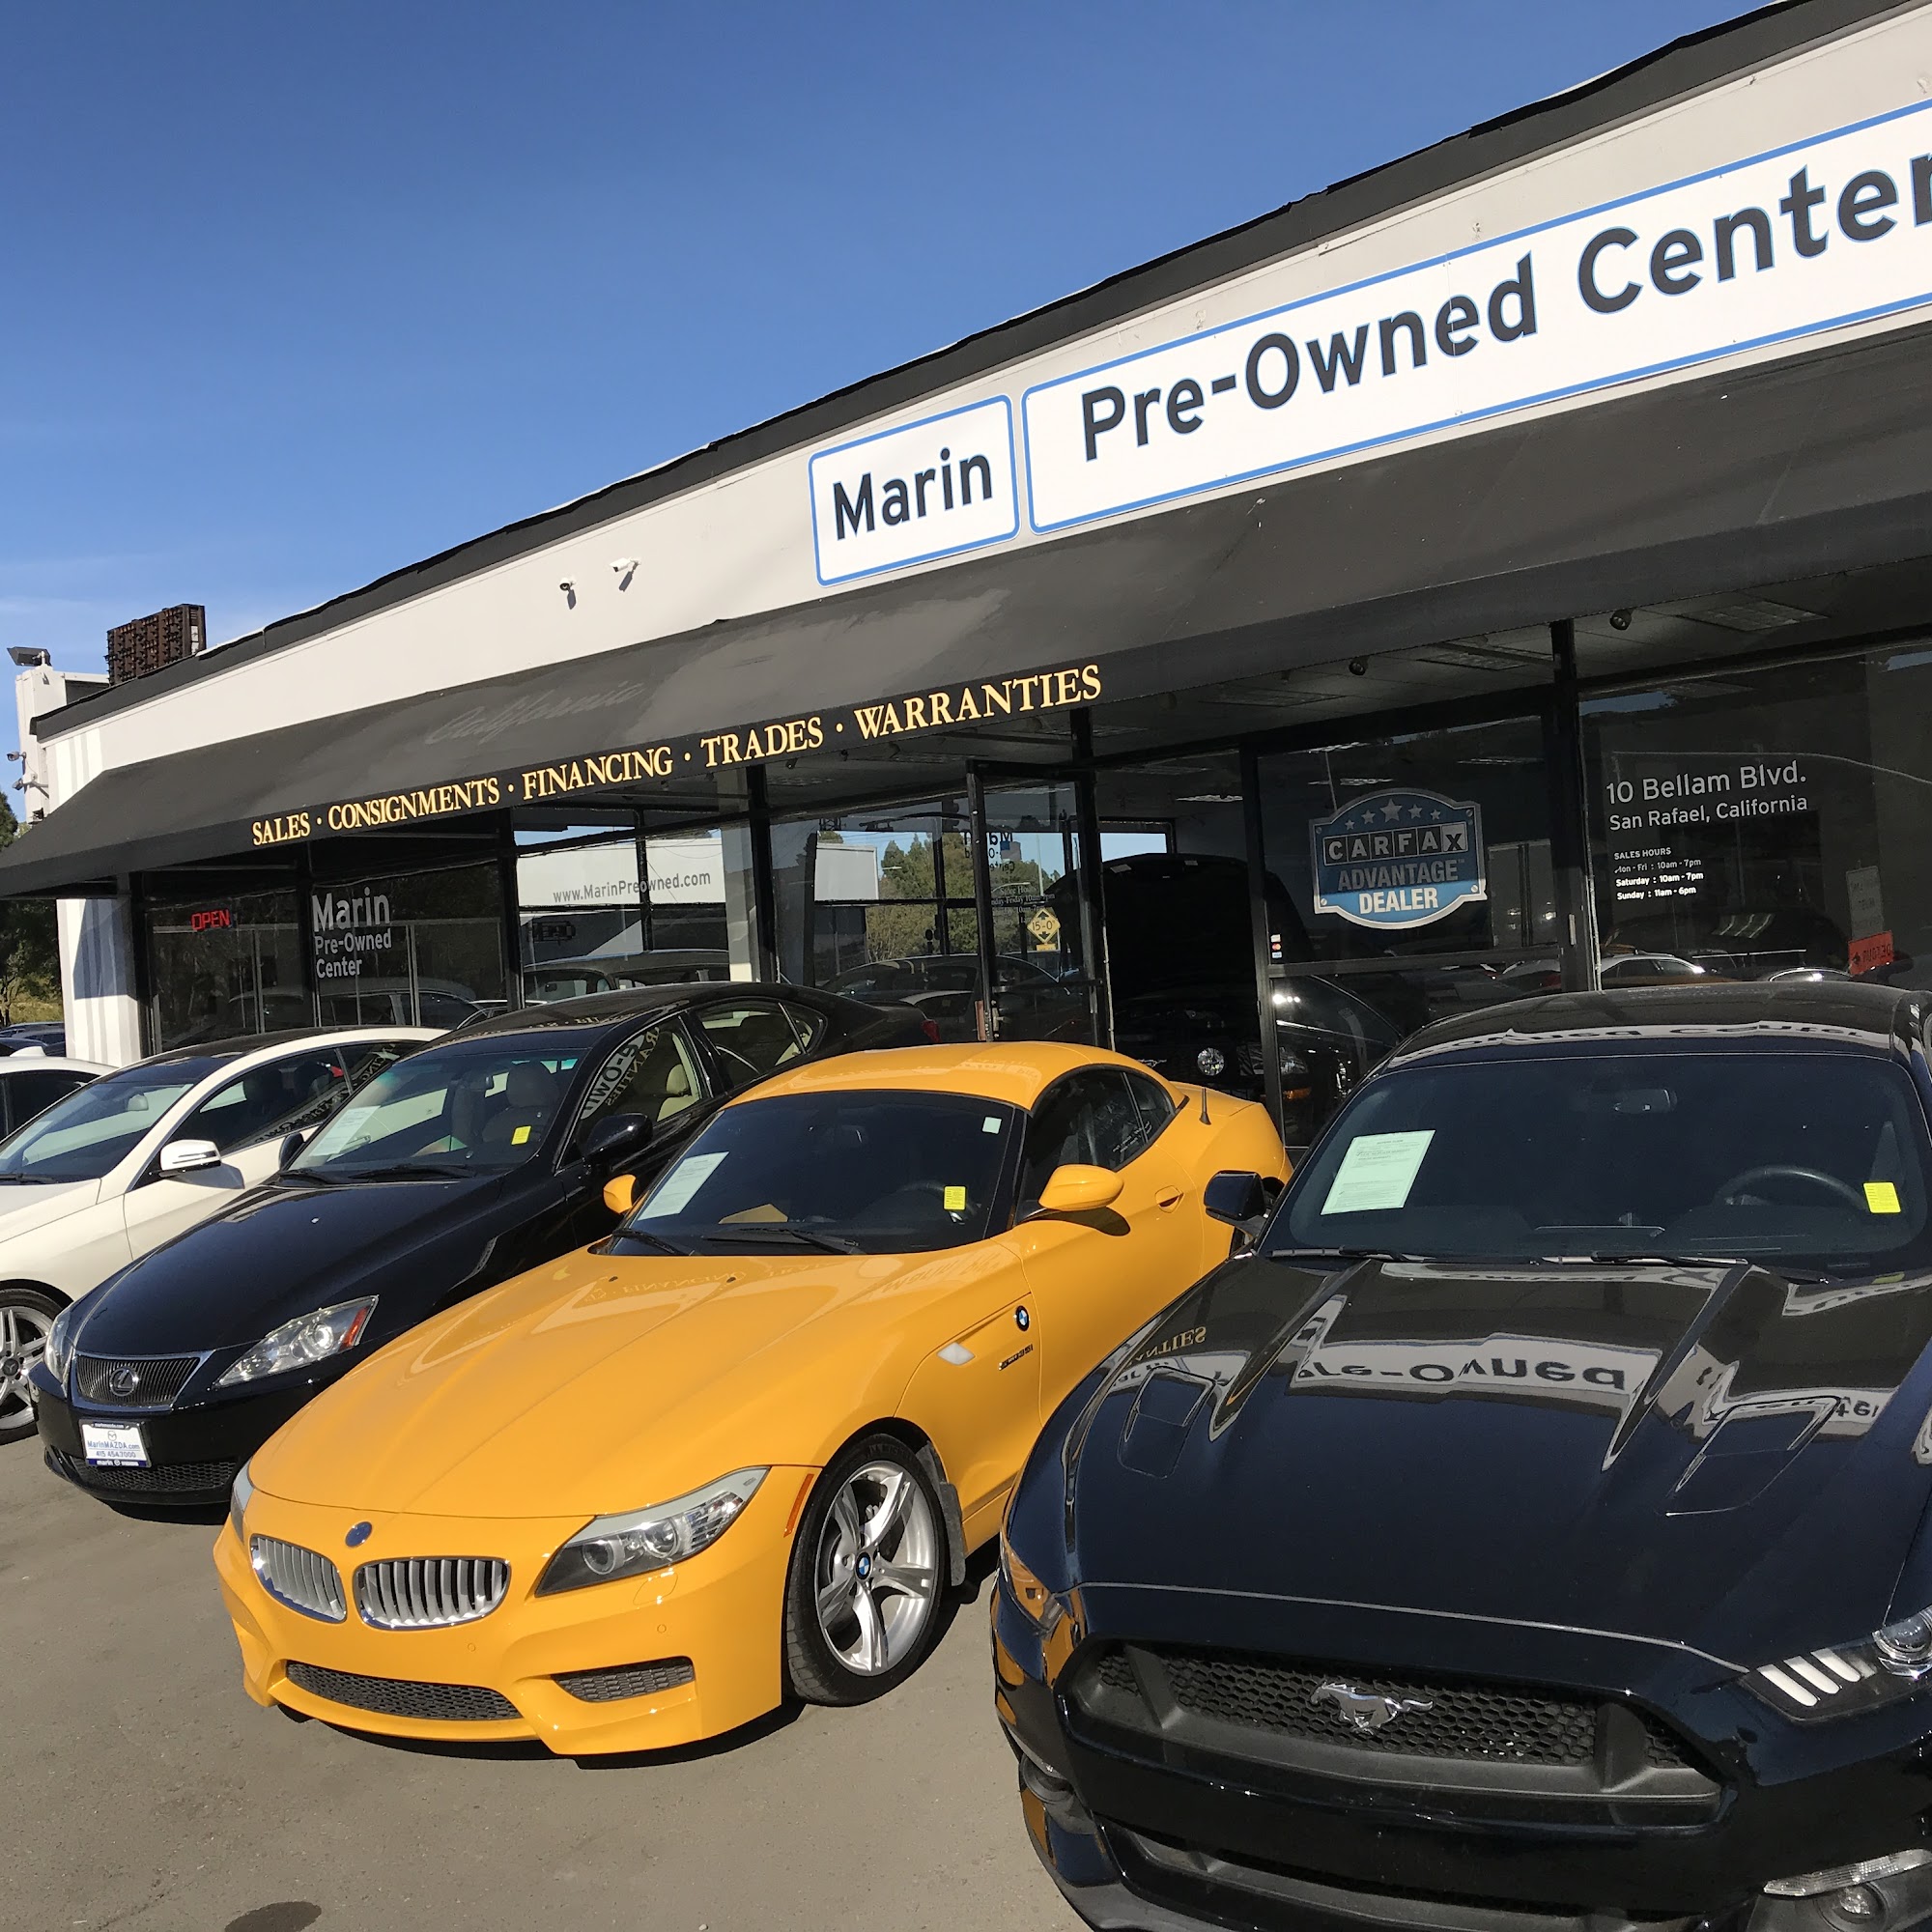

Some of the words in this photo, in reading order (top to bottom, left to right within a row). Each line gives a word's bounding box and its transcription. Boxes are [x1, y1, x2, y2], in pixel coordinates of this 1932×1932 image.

[1082, 250, 1538, 462] Pre-Owned
[833, 447, 993, 541] Marin
[251, 811, 311, 846] SALES
[327, 777, 500, 831] CONSIGNMENTS
[522, 746, 674, 801] FINANCING
[699, 716, 825, 769] TRADES
[853, 664, 1102, 740] WARRANTIES
[1606, 781, 1634, 805] 10
[1642, 773, 1730, 801] Bellam
[1740, 760, 1806, 789] Blvd.
[1609, 814, 1643, 831] San
[1648, 805, 1711, 827] Rafael,
[1716, 794, 1808, 819] California
[1327, 830, 1467, 861] CARFAX
[1613, 850, 1641, 861] SALES
[1641, 847, 1672, 858] HOURS
[1337, 860, 1459, 892] ADVANTAGE
[1615, 877, 1650, 887] Saturday
[1659, 874, 1681, 883] 10am
[1686, 871, 1704, 881] 7pm
[1636, 863, 1648, 871] Fri
[1657, 861, 1678, 869] 10am
[1684, 859, 1702, 867] 7pm
[553, 871, 712, 904] www.MarinPreowned.com
[1358, 887, 1439, 915] DEALER
[1616, 891, 1645, 900] Sunday
[1654, 888, 1673, 896] 11am
[1678, 886, 1697, 896] 6pm
[190, 908, 232, 931] OPEN
[311, 886, 390, 933] Marin
[314, 927, 392, 956] Pre-Owned
[315, 955, 363, 980] Center
[87, 1440, 140, 1449] MarinMAZDA.com
